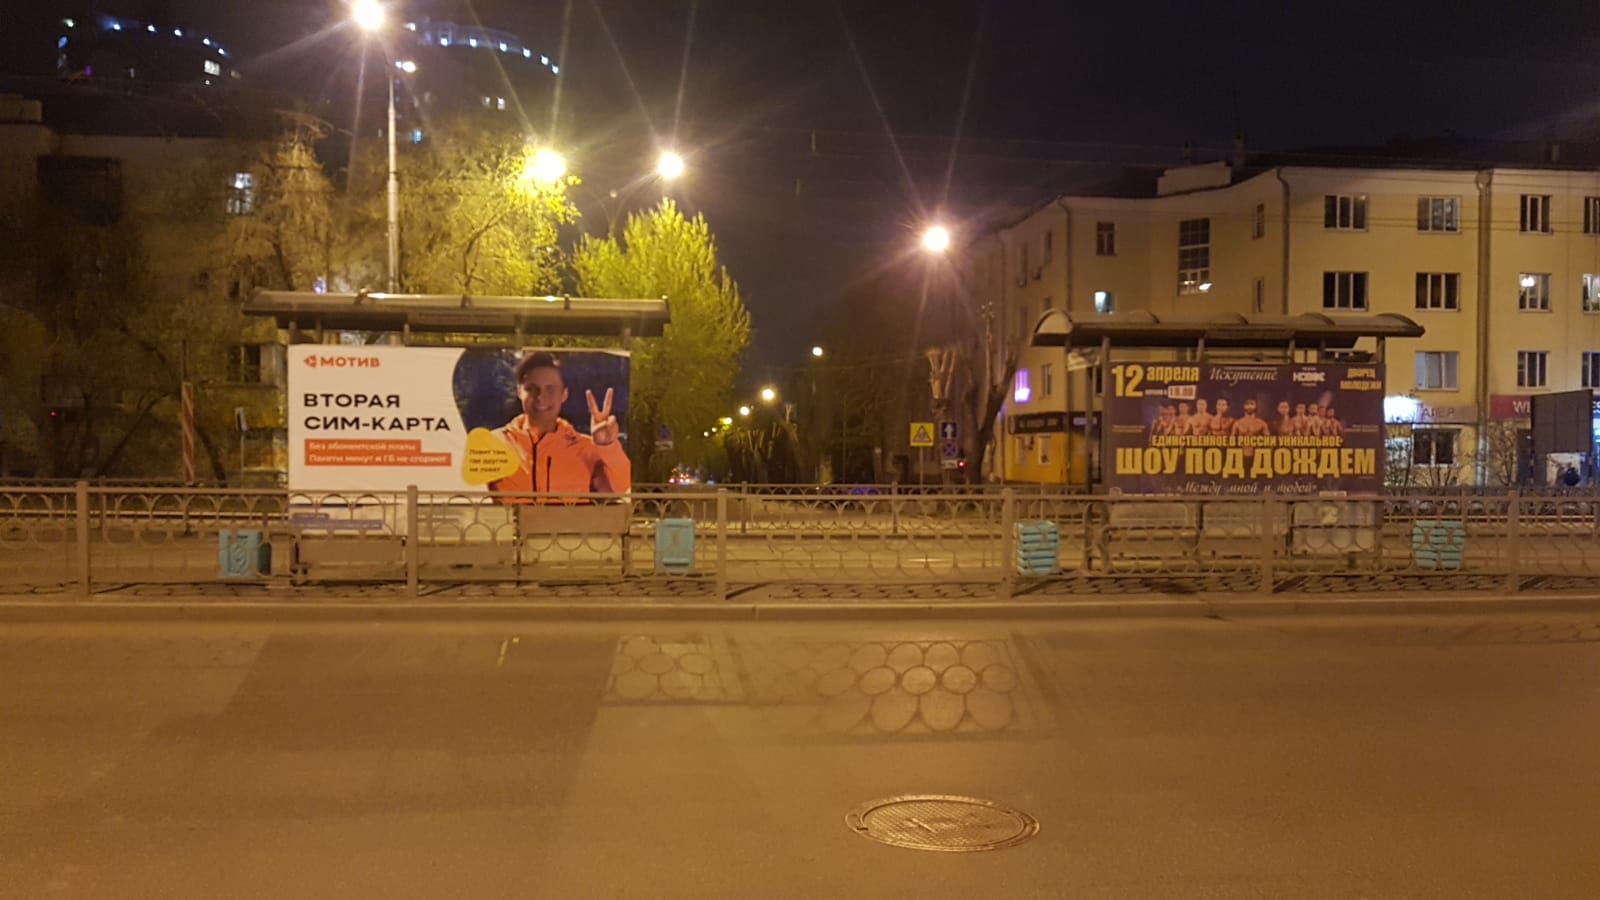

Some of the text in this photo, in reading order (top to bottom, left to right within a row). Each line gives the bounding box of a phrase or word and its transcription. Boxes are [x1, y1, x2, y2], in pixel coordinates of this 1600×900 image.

[320, 356, 381, 368] МОТИВ
[1111, 364, 1199, 397] 12 апреля
[1210, 367, 1279, 387] Искушение
[303, 393, 400, 408] ВТОРАЯ
[304, 416, 450, 431] СИМ-КАРТА
[1152, 435, 1229, 447] ЕДИНСТВЕННОЕ
[1238, 435, 1277, 447] РОССИИ
[1116, 447, 1376, 479] ШОУ ПОД ДОЖДЕМ
